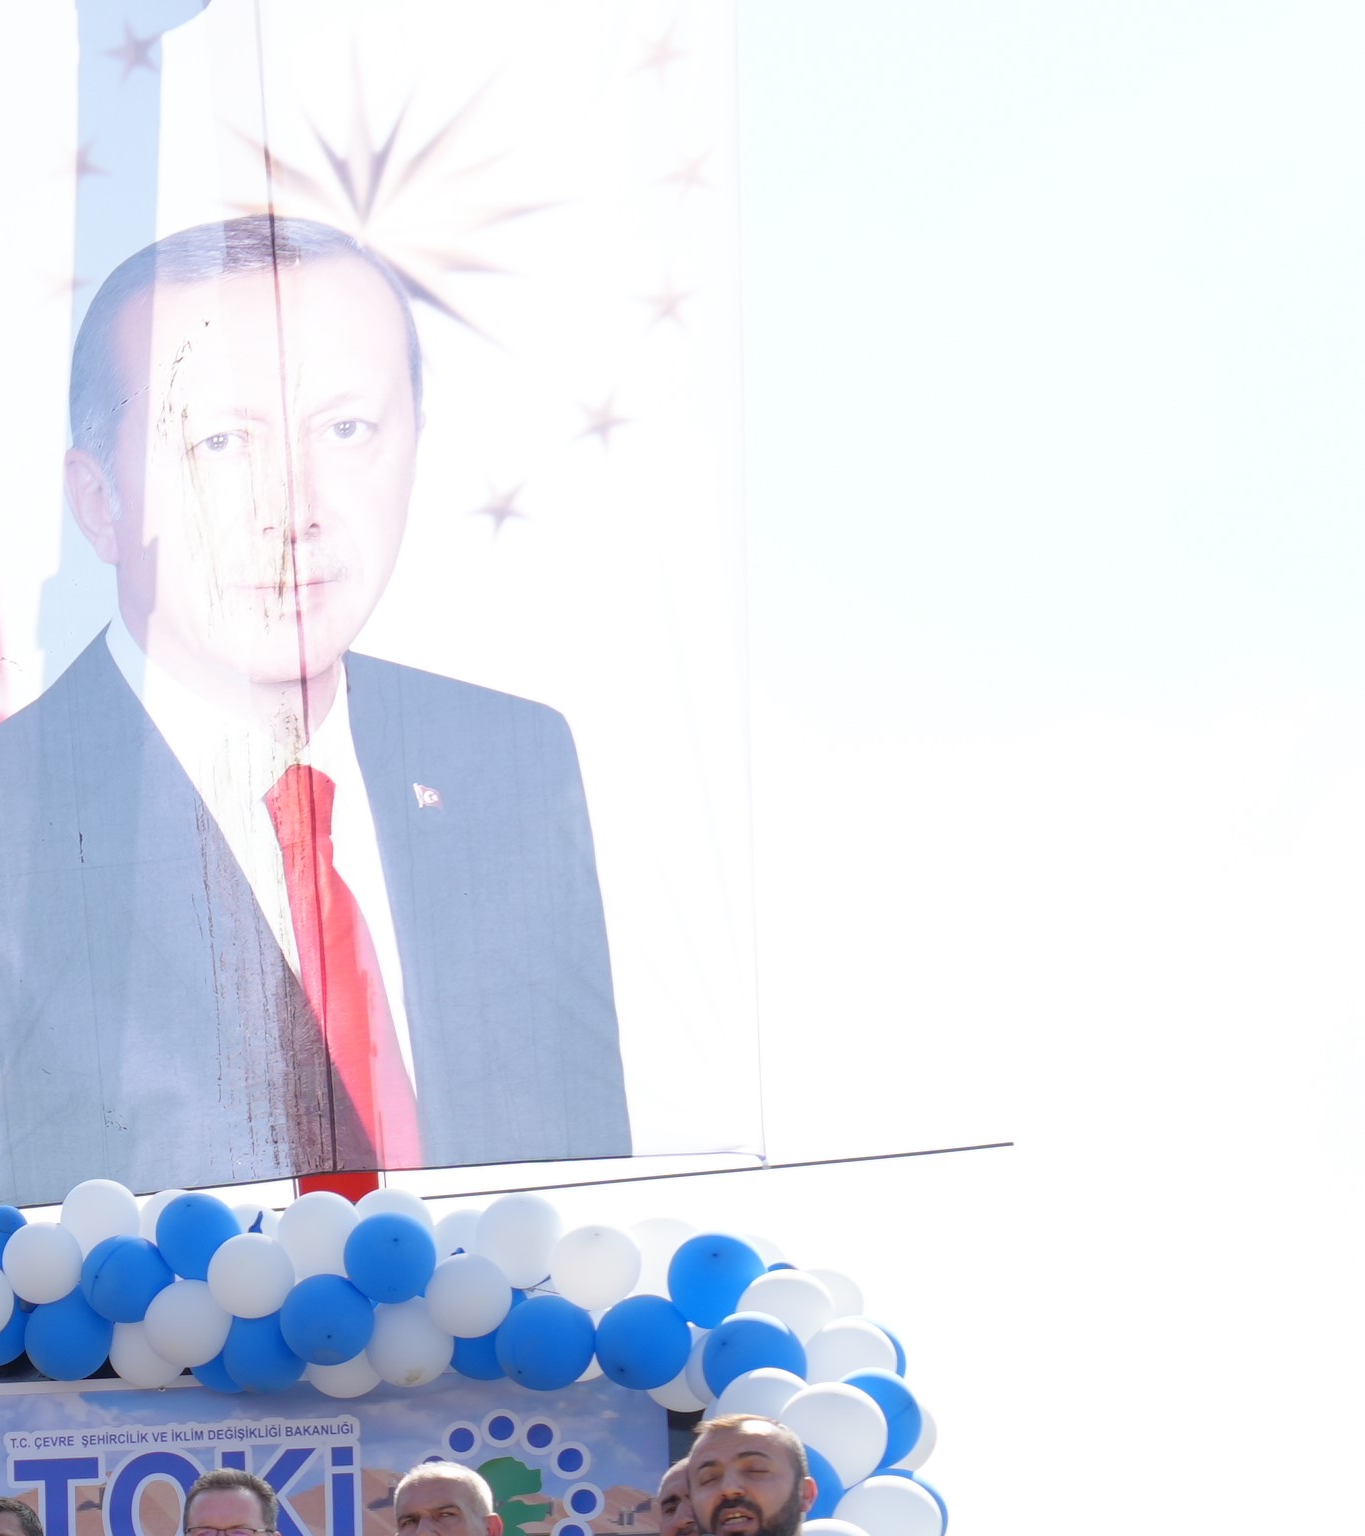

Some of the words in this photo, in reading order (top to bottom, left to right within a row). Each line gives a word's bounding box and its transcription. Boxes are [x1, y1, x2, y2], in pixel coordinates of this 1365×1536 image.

[10, 1437, 30, 1449] T.C.
[34, 1435, 74, 1450] ÇEVRE
[81, 1430, 149, 1448] ŞEHİRCİLİK
[152, 1431, 168, 1443] VE
[171, 1427, 204, 1442] İKLİM
[208, 1423, 281, 1442] DEĞİŞİKLİĞİ
[285, 1421, 354, 1437] BAKANLIĞI
